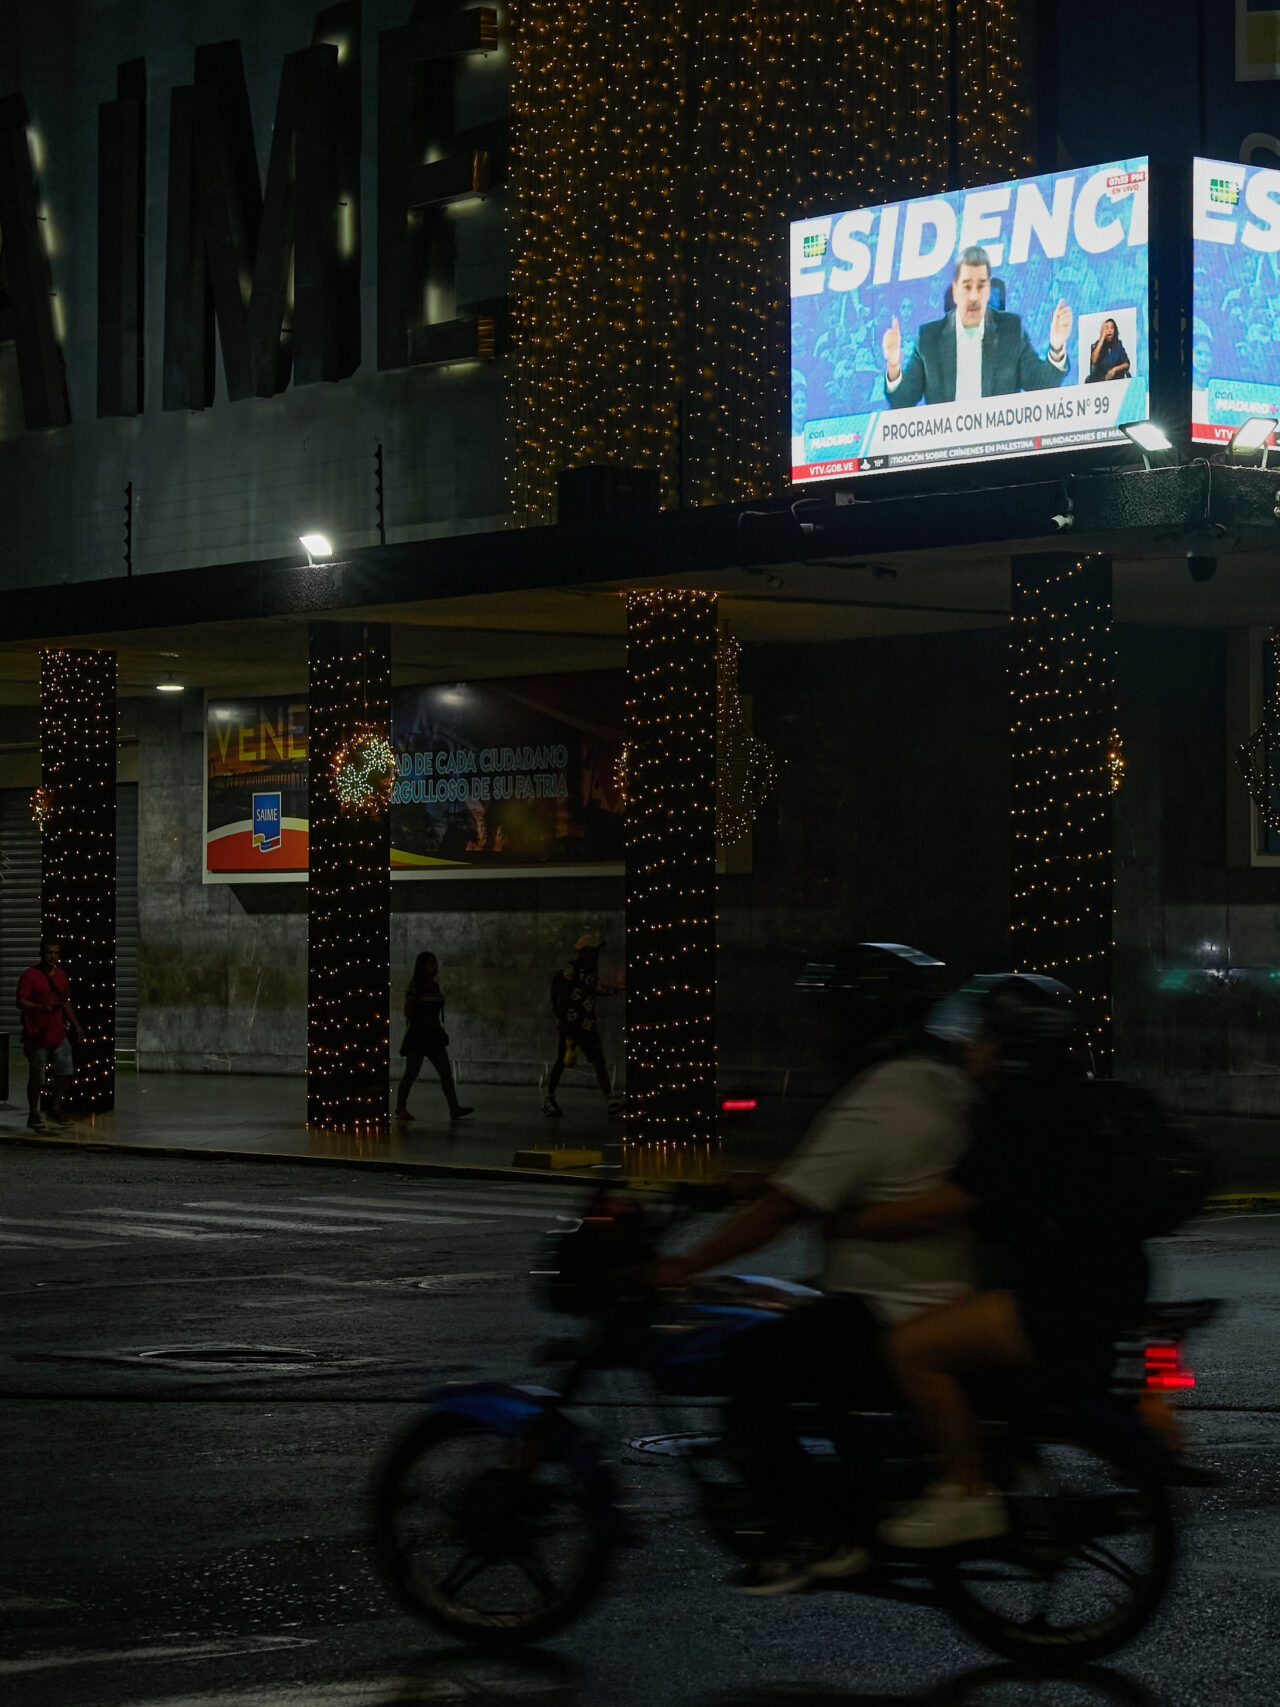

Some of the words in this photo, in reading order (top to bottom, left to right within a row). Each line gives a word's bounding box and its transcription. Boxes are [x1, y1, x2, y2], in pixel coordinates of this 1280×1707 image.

[883, 418, 953, 442] PROGRAMA
[956, 413, 983, 432] CON
[986, 404, 1042, 429] MADURO
[1046, 397, 1073, 420] MÁS
[1094, 396, 1110, 415] 99
[1041, 433, 1095, 446] INUNDACIONES
[1096, 431, 1108, 440] EN
[1213, 428, 1234, 440] VTV
[890, 454, 924, 465] TIGACIÓN
[925, 450, 948, 460] SOBRE
[949, 445, 985, 457] CRÍMENES
[985, 444, 996, 453] EN
[996, 439, 1034, 451] PALESTINA
[809, 462, 854, 475] VTV.GOB.VE
[211, 704, 307, 764] VENE
[394, 752, 413, 776] AD
[414, 751, 433, 776] DE
[436, 748, 477, 774] CADA
[479, 744, 568, 773] CIUDADANO
[391, 777, 469, 804] RGULLOSO
[471, 776, 490, 801] DE
[492, 776, 513, 800] SU
[515, 773, 569, 798] PATRIA
[256, 808, 278, 822] SAIME
